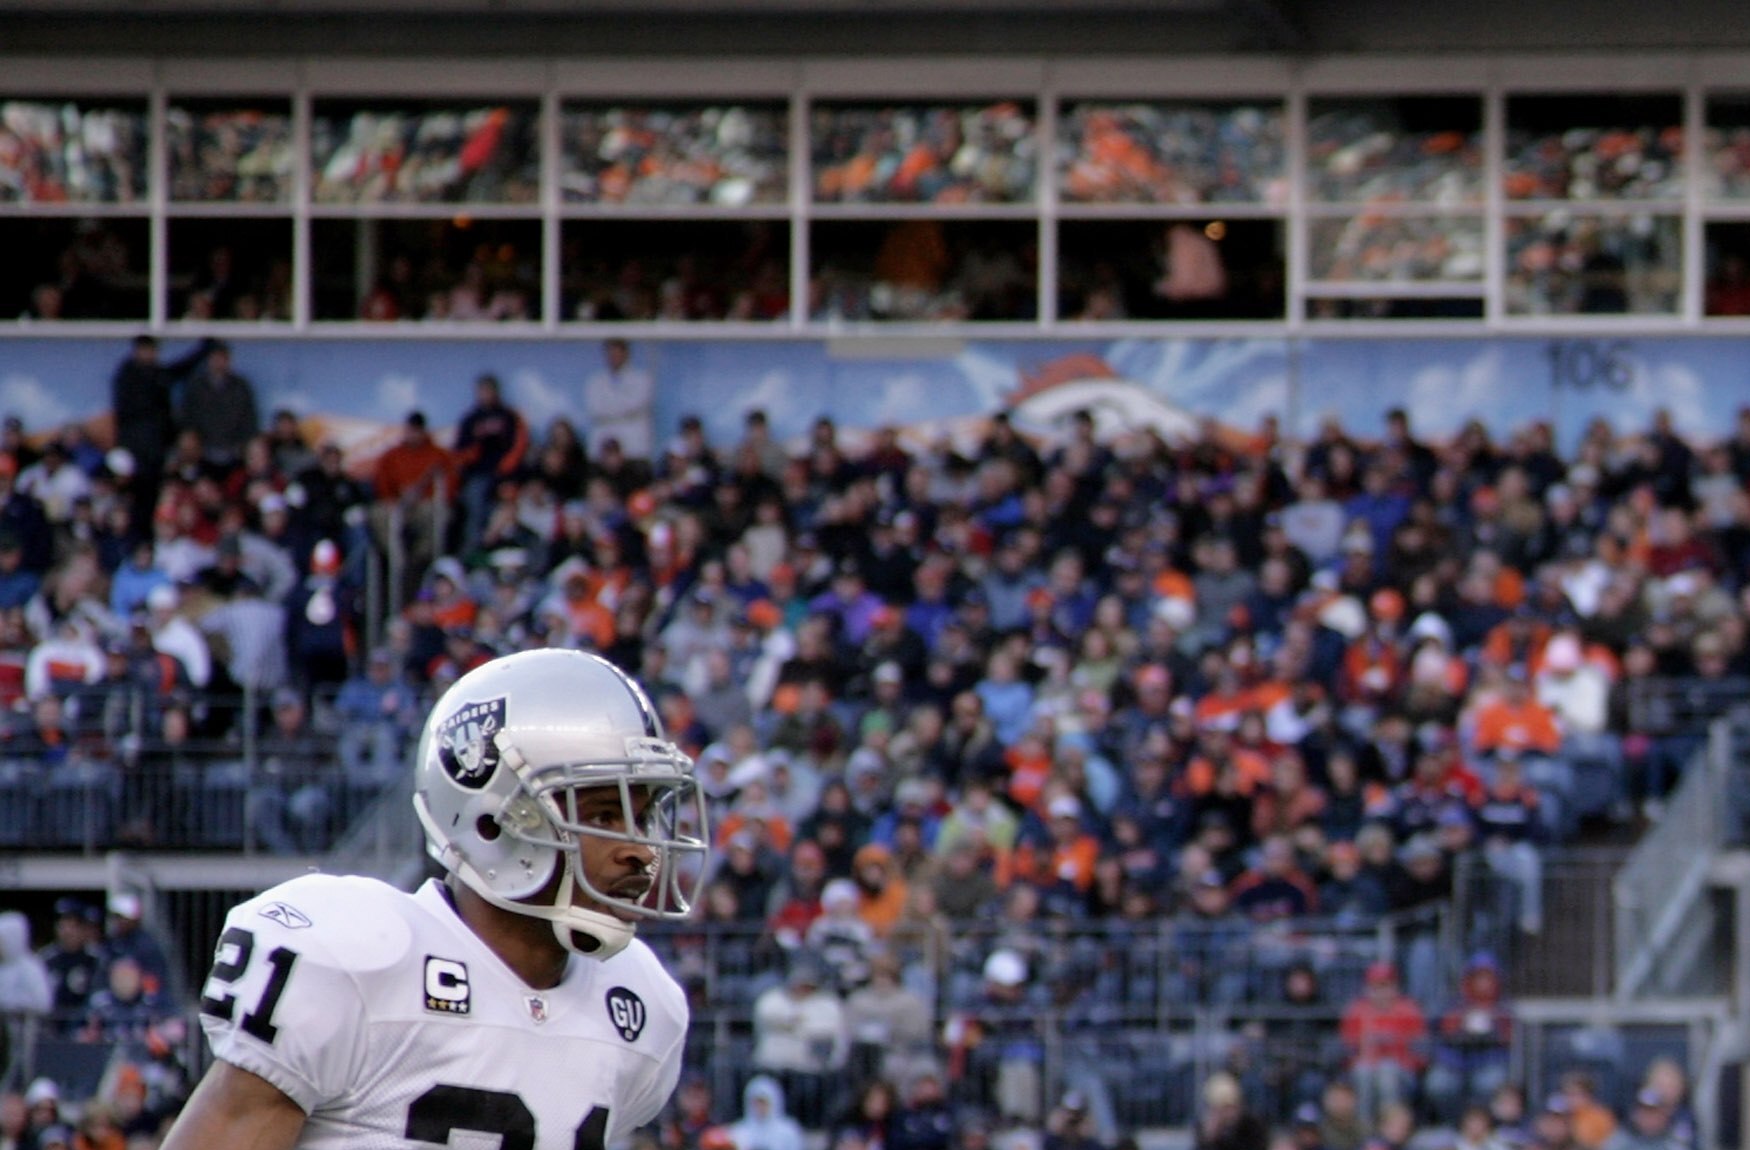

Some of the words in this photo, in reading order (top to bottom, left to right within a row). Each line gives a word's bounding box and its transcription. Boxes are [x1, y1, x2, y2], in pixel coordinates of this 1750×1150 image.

[1547, 339, 1635, 394] 106
[200, 925, 299, 1045] 21
[425, 958, 469, 1001] C
[610, 996, 644, 1033] GU
